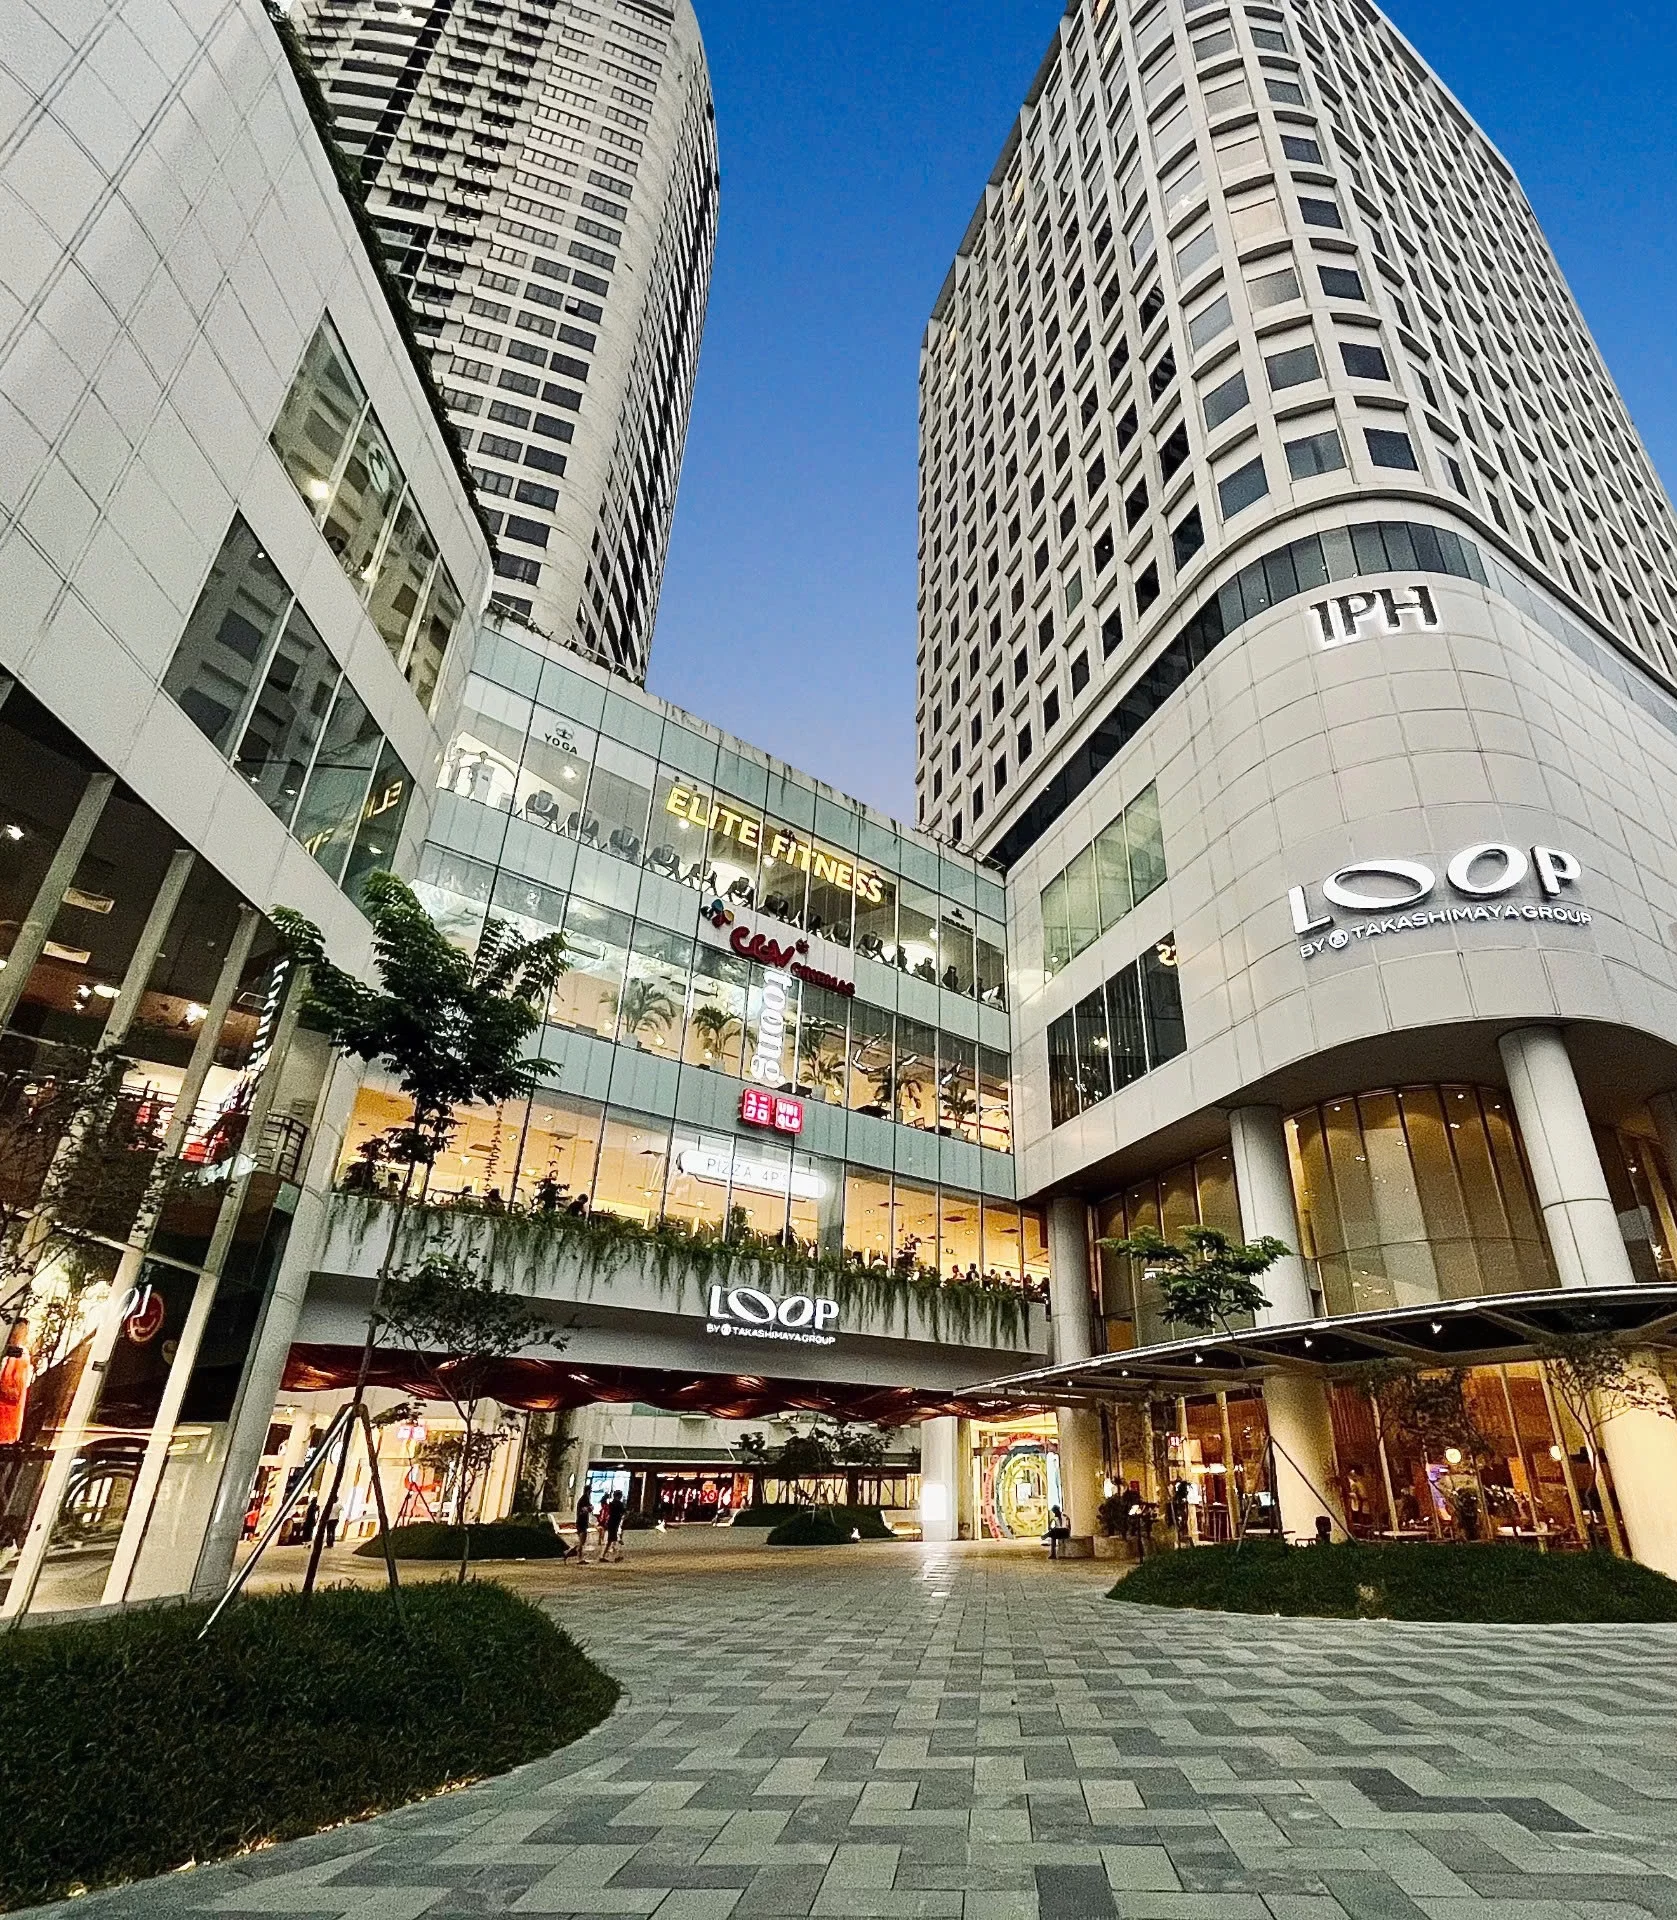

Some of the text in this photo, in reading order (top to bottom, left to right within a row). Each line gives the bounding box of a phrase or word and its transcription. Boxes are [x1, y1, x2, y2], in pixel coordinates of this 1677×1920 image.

[544, 733, 578, 755] YOGA
[665, 785, 884, 903] ELITE FITNESS
[1287, 842, 1583, 935] LOOP
[729, 926, 796, 968] CGV
[1300, 937, 1325, 959] BY
[790, 961, 856, 997] CINEMAS
[750, 970, 793, 1089] toong
[707, 1158, 751, 1178] PIZZA
[709, 1284, 840, 1330] LOOP
[706, 1322, 720, 1333] BY
